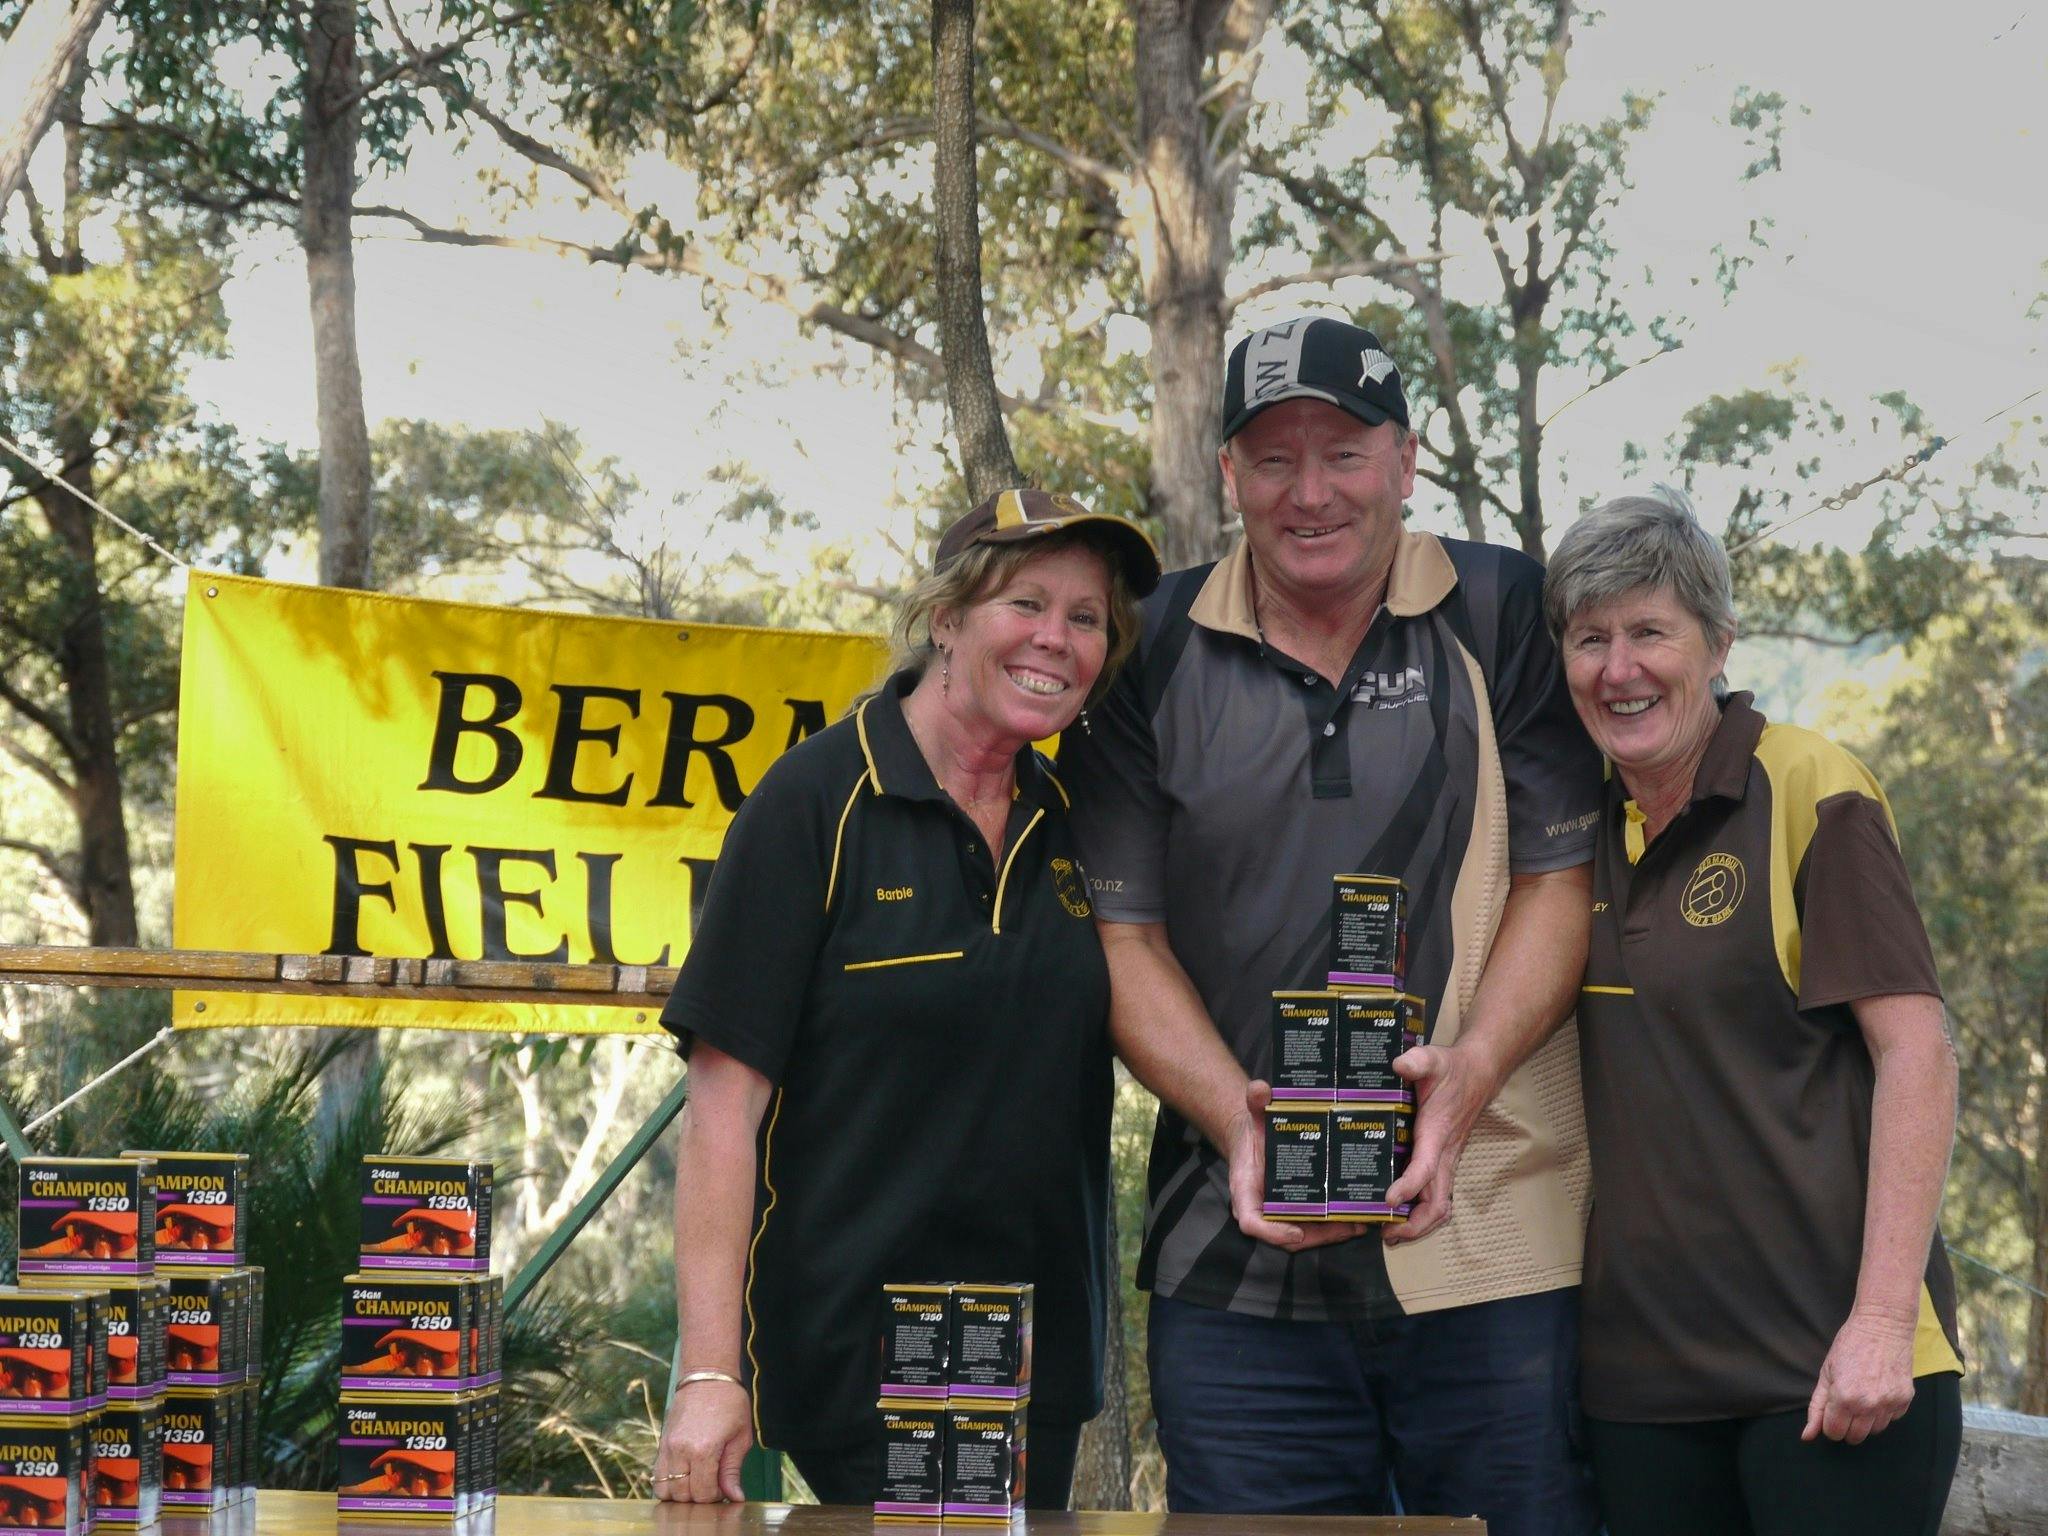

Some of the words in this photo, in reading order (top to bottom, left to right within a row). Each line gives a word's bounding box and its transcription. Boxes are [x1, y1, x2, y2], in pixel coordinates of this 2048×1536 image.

[1545, 809, 1600, 837] www.gun
[1342, 894, 1389, 902] CHAMPION
[1367, 903, 1390, 912] 1350
[1282, 1009, 1328, 1017] CHAMPION
[1348, 1010, 1395, 1018] CHAMPION
[1307, 1017, 1329, 1025] 1350
[1373, 1018, 1396, 1027] 1350
[1275, 1123, 1320, 1131] CHAMPION
[1340, 1122, 1385, 1130] CHAMPION
[1300, 1132, 1321, 1140] 1350
[1364, 1130, 1386, 1139] 1350
[32, 1181, 127, 1197] CHAMPION
[374, 1180, 466, 1196] CHAMPION
[186, 1190, 227, 1205] 1350
[88, 1197, 129, 1211] 1350
[428, 1196, 468, 1209] 1350
[355, 1300, 450, 1316] CHAMPION
[894, 1304, 942, 1312] CHAMPION
[962, 1304, 1009, 1313] CHAMPION
[171, 1310, 211, 1324] 1350
[920, 1313, 943, 1322] 1350
[987, 1313, 1011, 1322] 1350
[411, 1316, 452, 1330] 1350
[19, 1333, 62, 1348] 1350
[351, 1421, 444, 1436] CHAMPION
[886, 1421, 934, 1430] CHAMPION
[956, 1421, 1004, 1431] CHAMPION
[164, 1430, 204, 1443] 1350
[912, 1430, 935, 1439] 1350
[981, 1431, 1005, 1440] 1350
[405, 1436, 447, 1450] 1350
[15, 1462, 59, 1476] 1350
